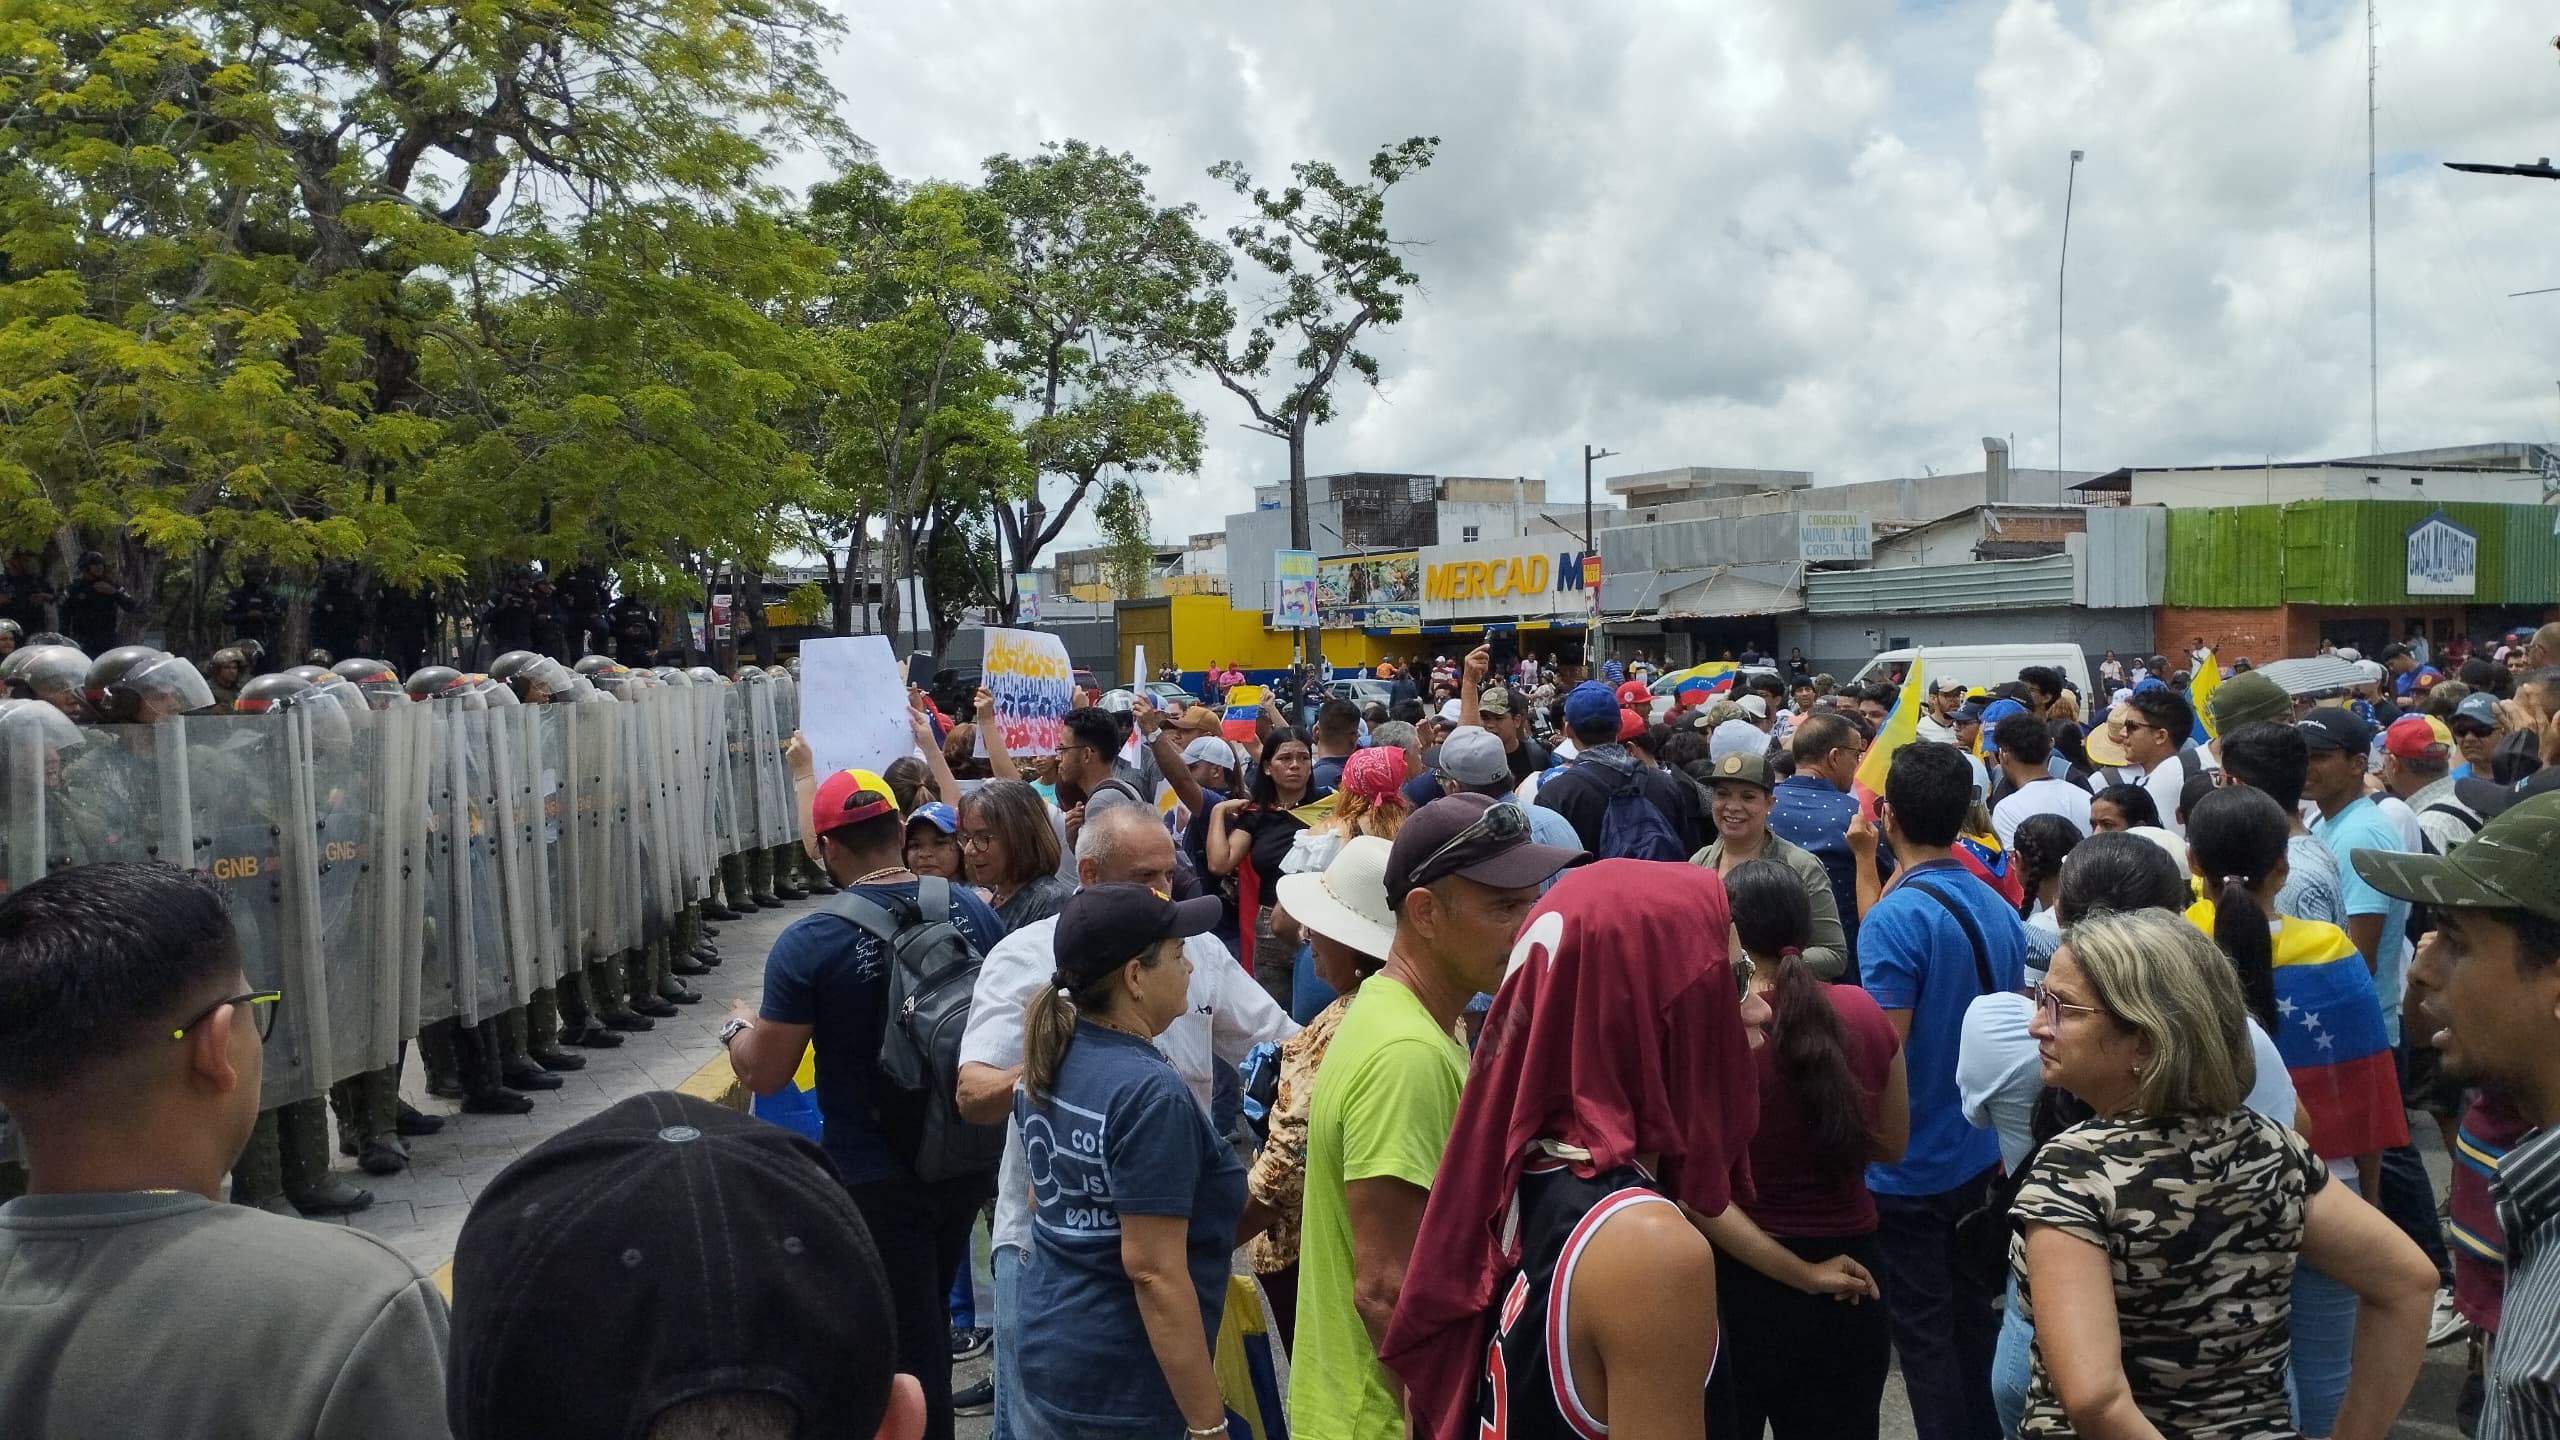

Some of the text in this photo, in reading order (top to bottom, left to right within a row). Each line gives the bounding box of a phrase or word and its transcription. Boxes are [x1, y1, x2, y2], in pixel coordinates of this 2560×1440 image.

[1807, 514, 1857, 526] COMERCIAL
[1801, 527, 1868, 542] MUNDO AZUL
[2409, 527, 2431, 576] CASA
[325, 840, 356, 861] GNB
[214, 856, 260, 880] GNB
